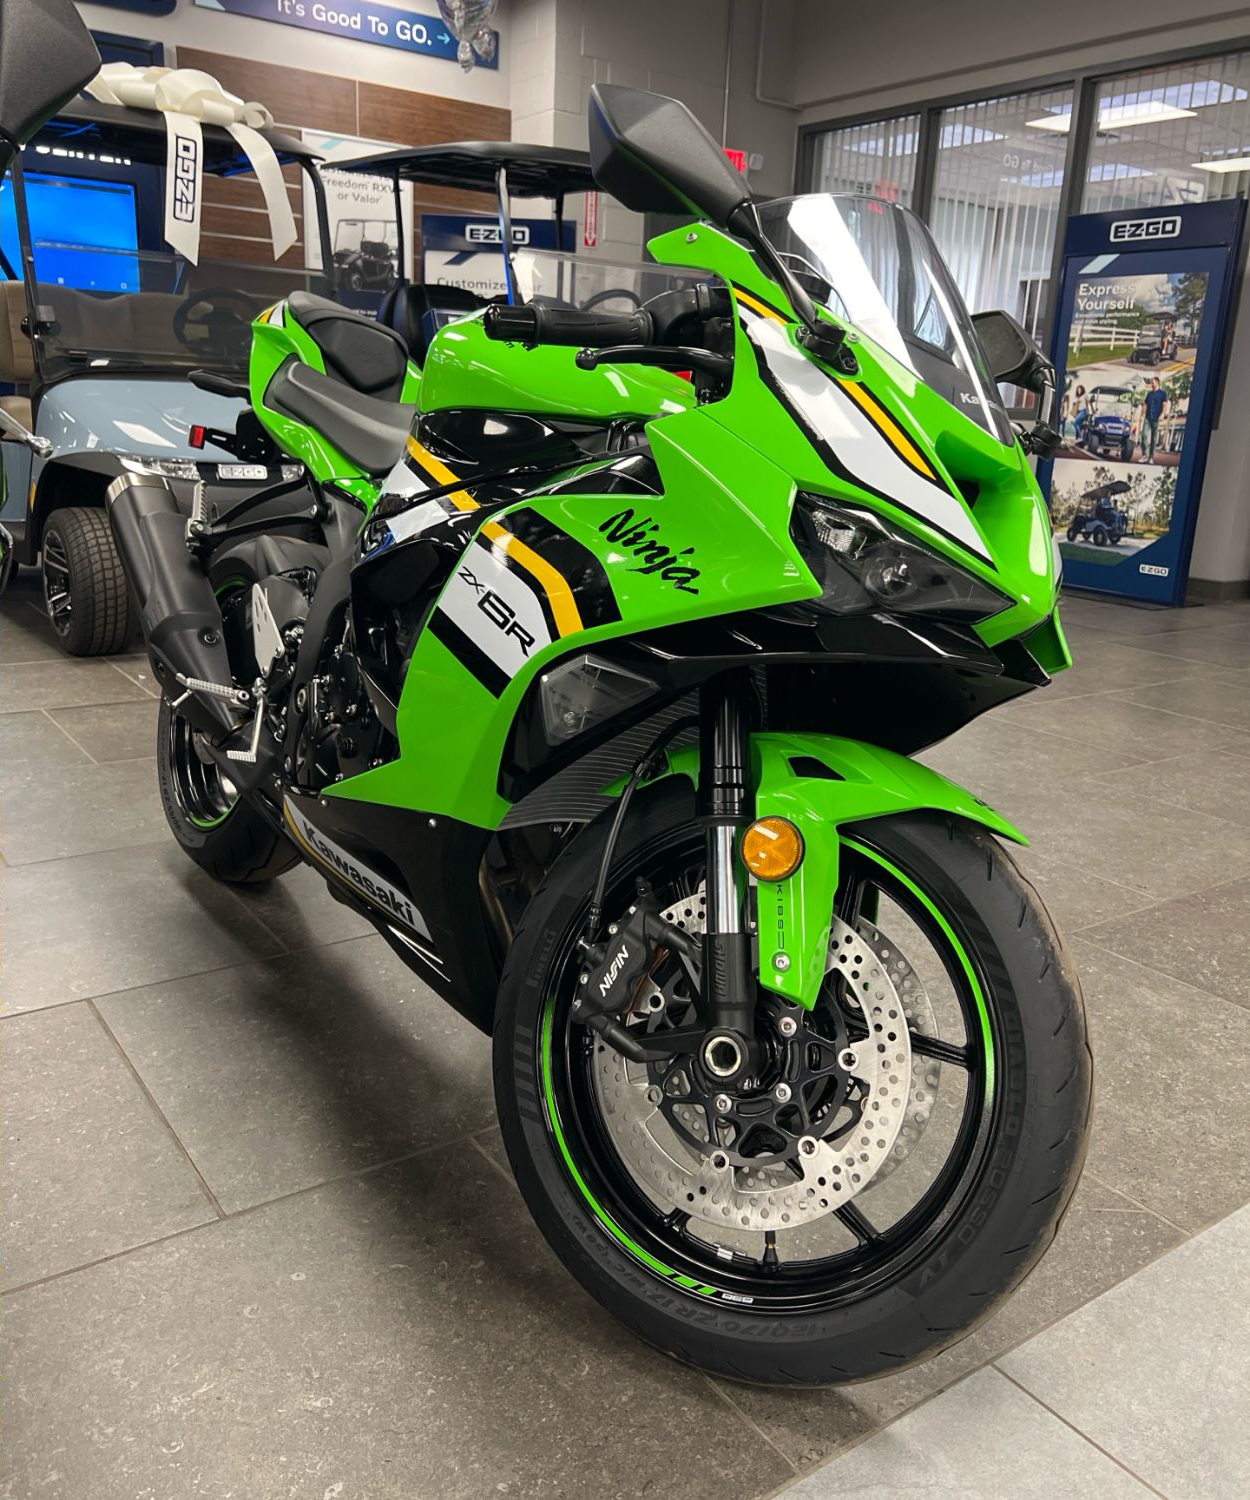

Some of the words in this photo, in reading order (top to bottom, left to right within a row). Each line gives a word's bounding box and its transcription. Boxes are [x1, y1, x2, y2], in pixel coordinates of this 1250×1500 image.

[276, 0, 305, 17] It's
[312, 4, 361, 29] Good
[367, 15, 389, 36] To
[395, 20, 432, 46] GO.
[174, 135, 197, 223] EZGO
[337, 192, 349, 201] or
[352, 193, 380, 205] Valor
[468, 228, 527, 242] EZO
[1112, 218, 1179, 240] EZGO
[1079, 283, 1136, 298] Express
[1077, 297, 1137, 311] Yourself
[598, 508, 701, 595] Ninja
[302, 820, 416, 926] Kawasaki
